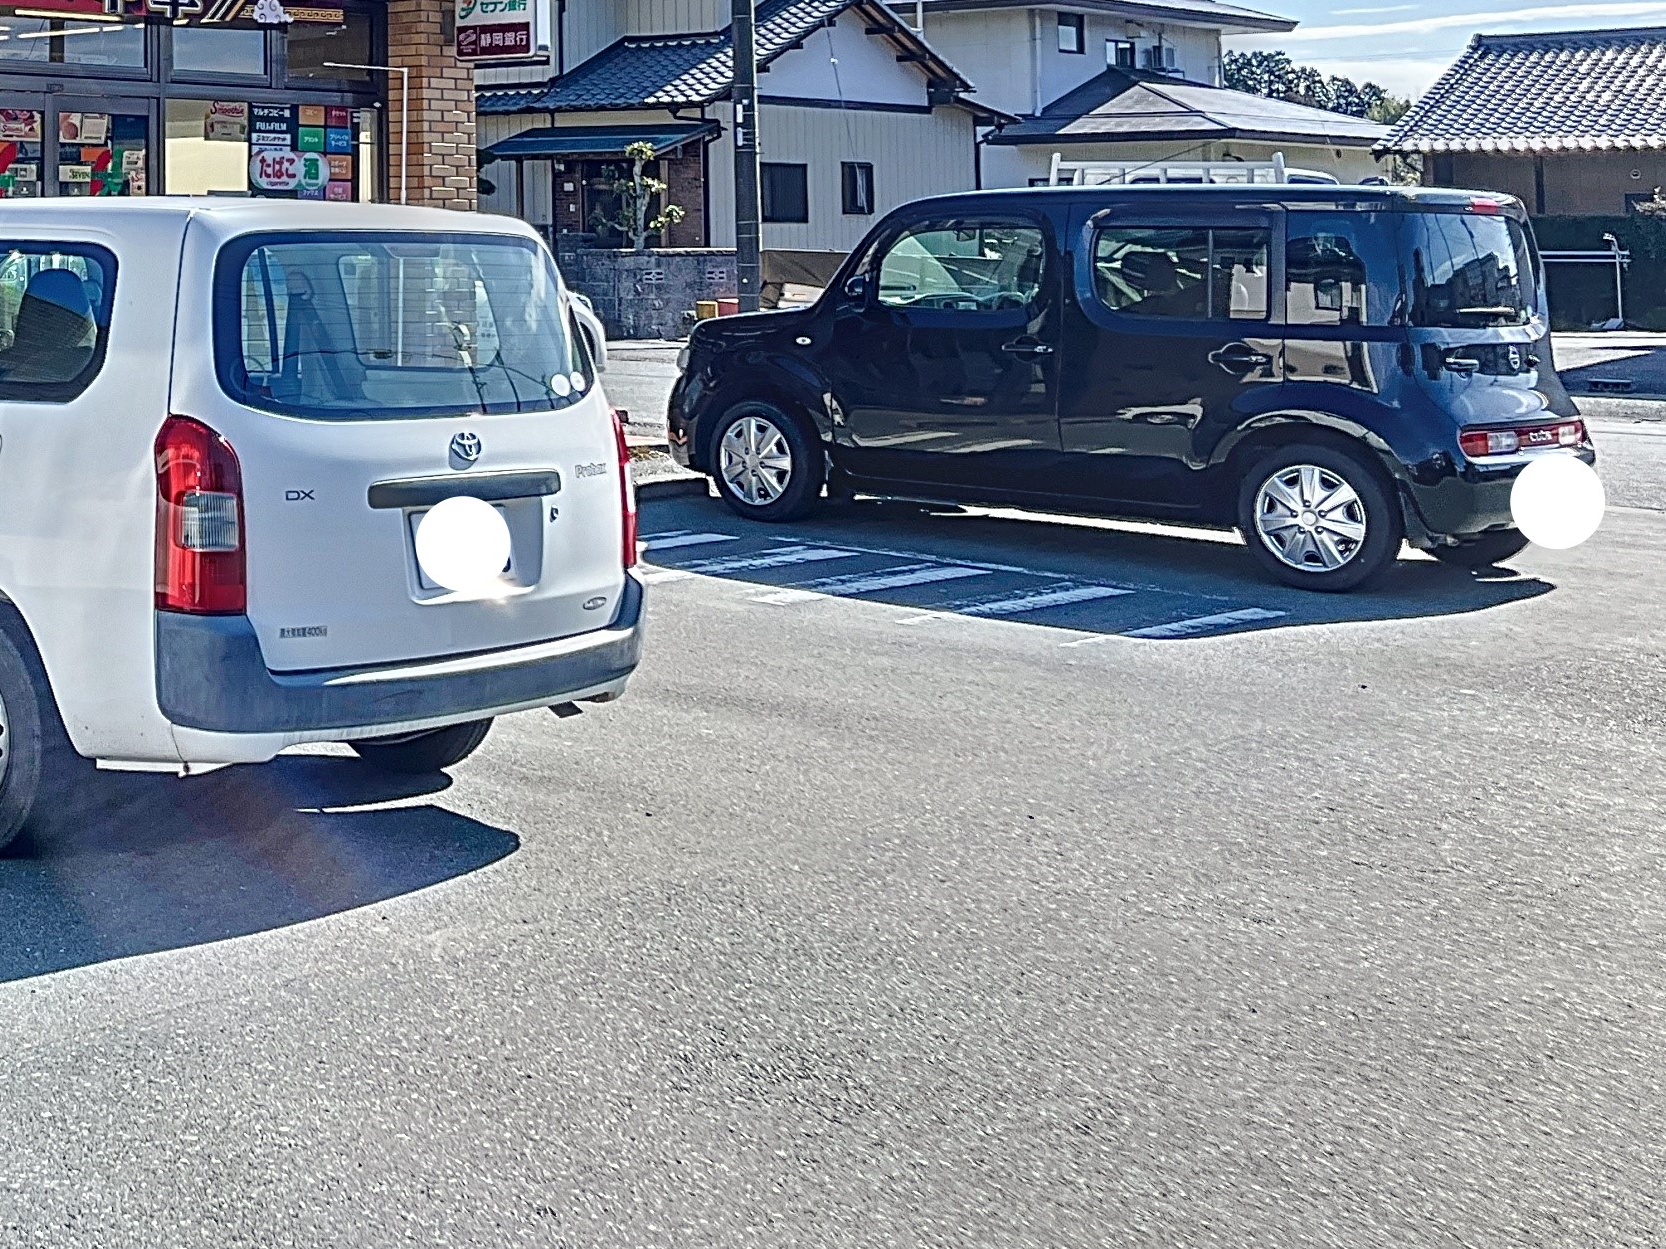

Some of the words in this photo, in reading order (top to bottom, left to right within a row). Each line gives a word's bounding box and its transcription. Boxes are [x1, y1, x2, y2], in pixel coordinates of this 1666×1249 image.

[480, 0, 527, 13] セブン銀行
[480, 31, 527, 47] 静岡銀行
[259, 156, 297, 180] たばこ
[303, 157, 320, 181] 酒
[285, 489, 316, 501] DX
